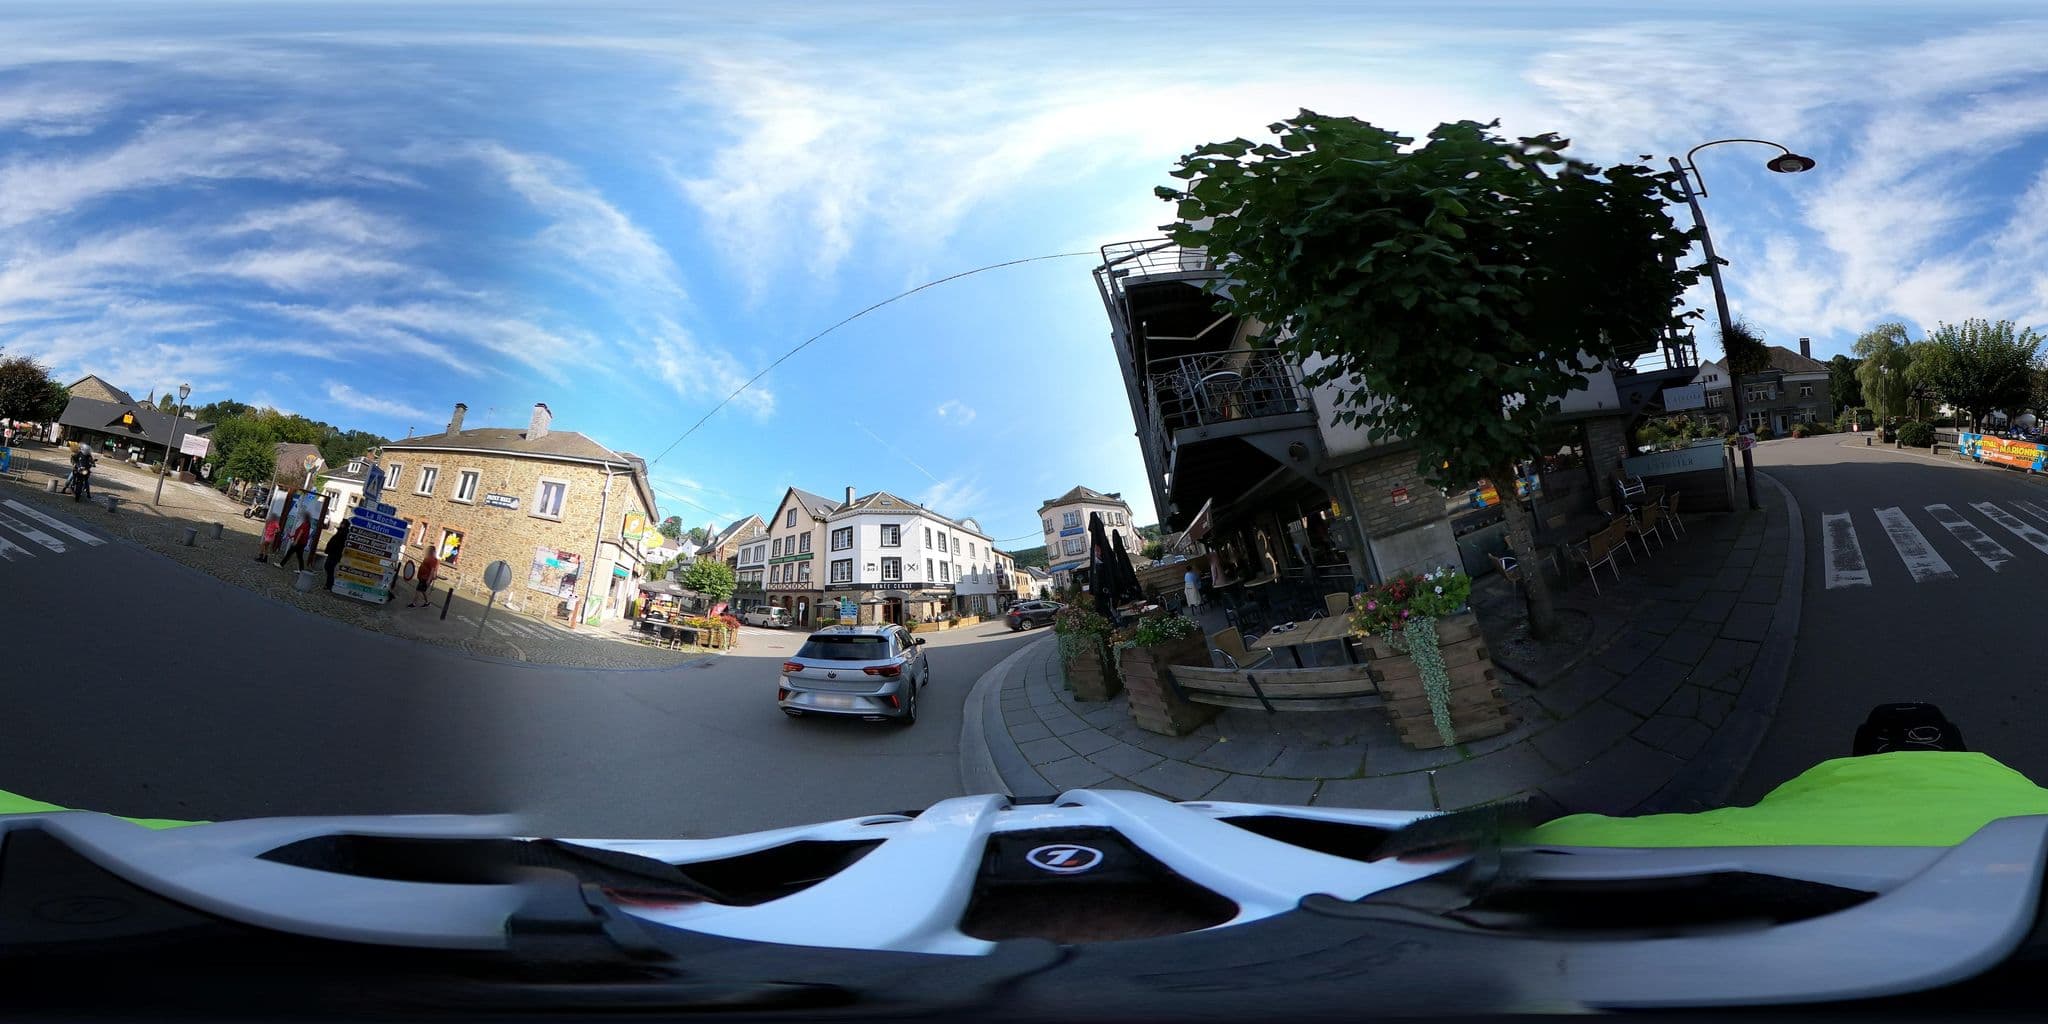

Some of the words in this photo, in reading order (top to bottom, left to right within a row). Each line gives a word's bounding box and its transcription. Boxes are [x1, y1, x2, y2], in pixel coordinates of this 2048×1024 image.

[366, 511, 375, 519] La
[376, 515, 398, 526] Roche
[366, 522, 390, 534] Nadrin
